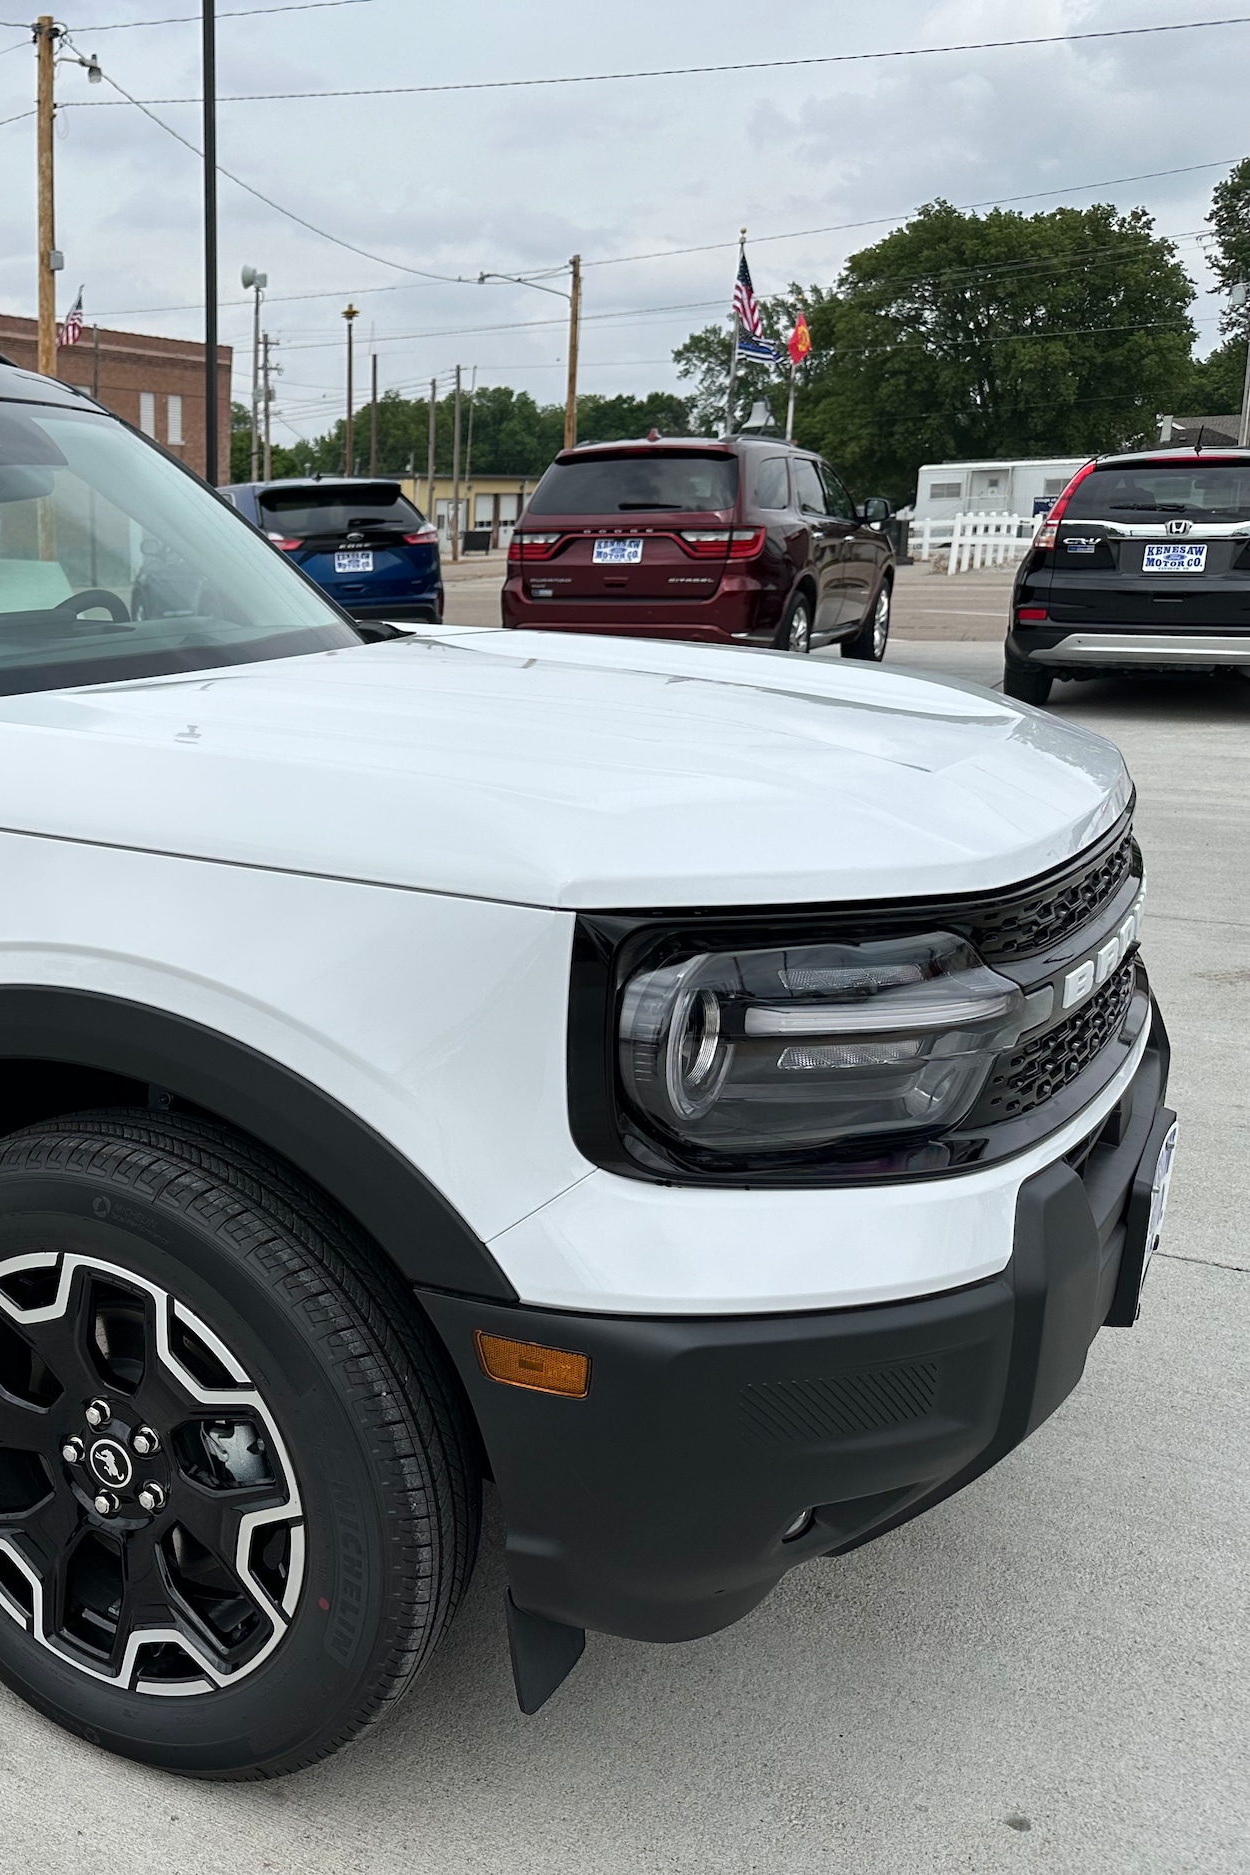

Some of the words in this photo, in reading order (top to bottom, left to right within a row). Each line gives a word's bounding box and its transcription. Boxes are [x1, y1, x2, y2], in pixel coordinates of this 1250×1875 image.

[596, 540, 641, 549] KENESAW
[1062, 537, 1102, 545] CR-V
[595, 550, 626, 559] MOTOR
[1147, 546, 1205, 556] KENESAW
[1145, 557, 1185, 567] MOTOR
[1186, 557, 1203, 567] CO.
[113, 1203, 158, 1229] MICHELIN
[329, 1479, 363, 1658] MICHELIN
